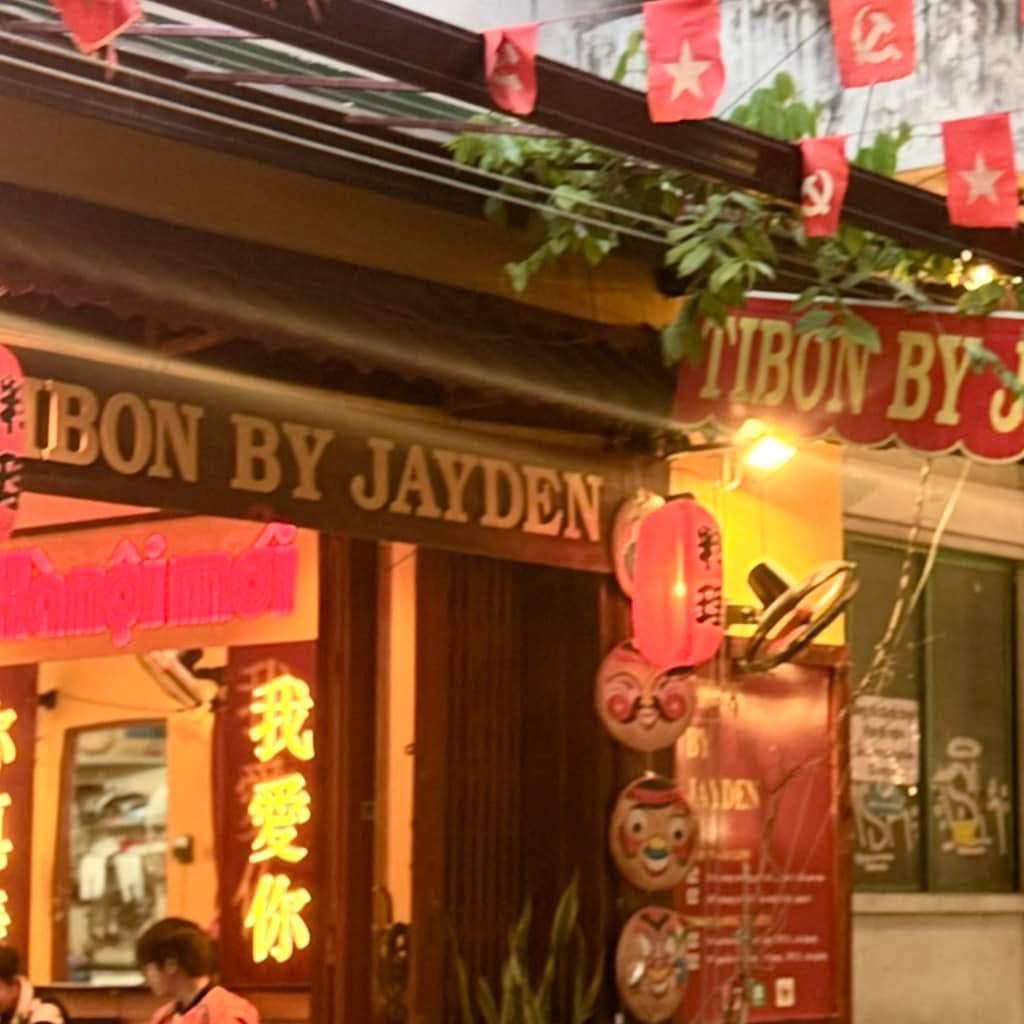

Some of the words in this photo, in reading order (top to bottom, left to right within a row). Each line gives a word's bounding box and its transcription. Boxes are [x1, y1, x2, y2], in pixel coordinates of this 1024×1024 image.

[699, 318, 880, 414] TIBON
[887, 331, 982, 424] BY
[230, 413, 333, 500] BY
[350, 437, 604, 541] JAYDEN
[245, 674, 315, 963] 我愛你
